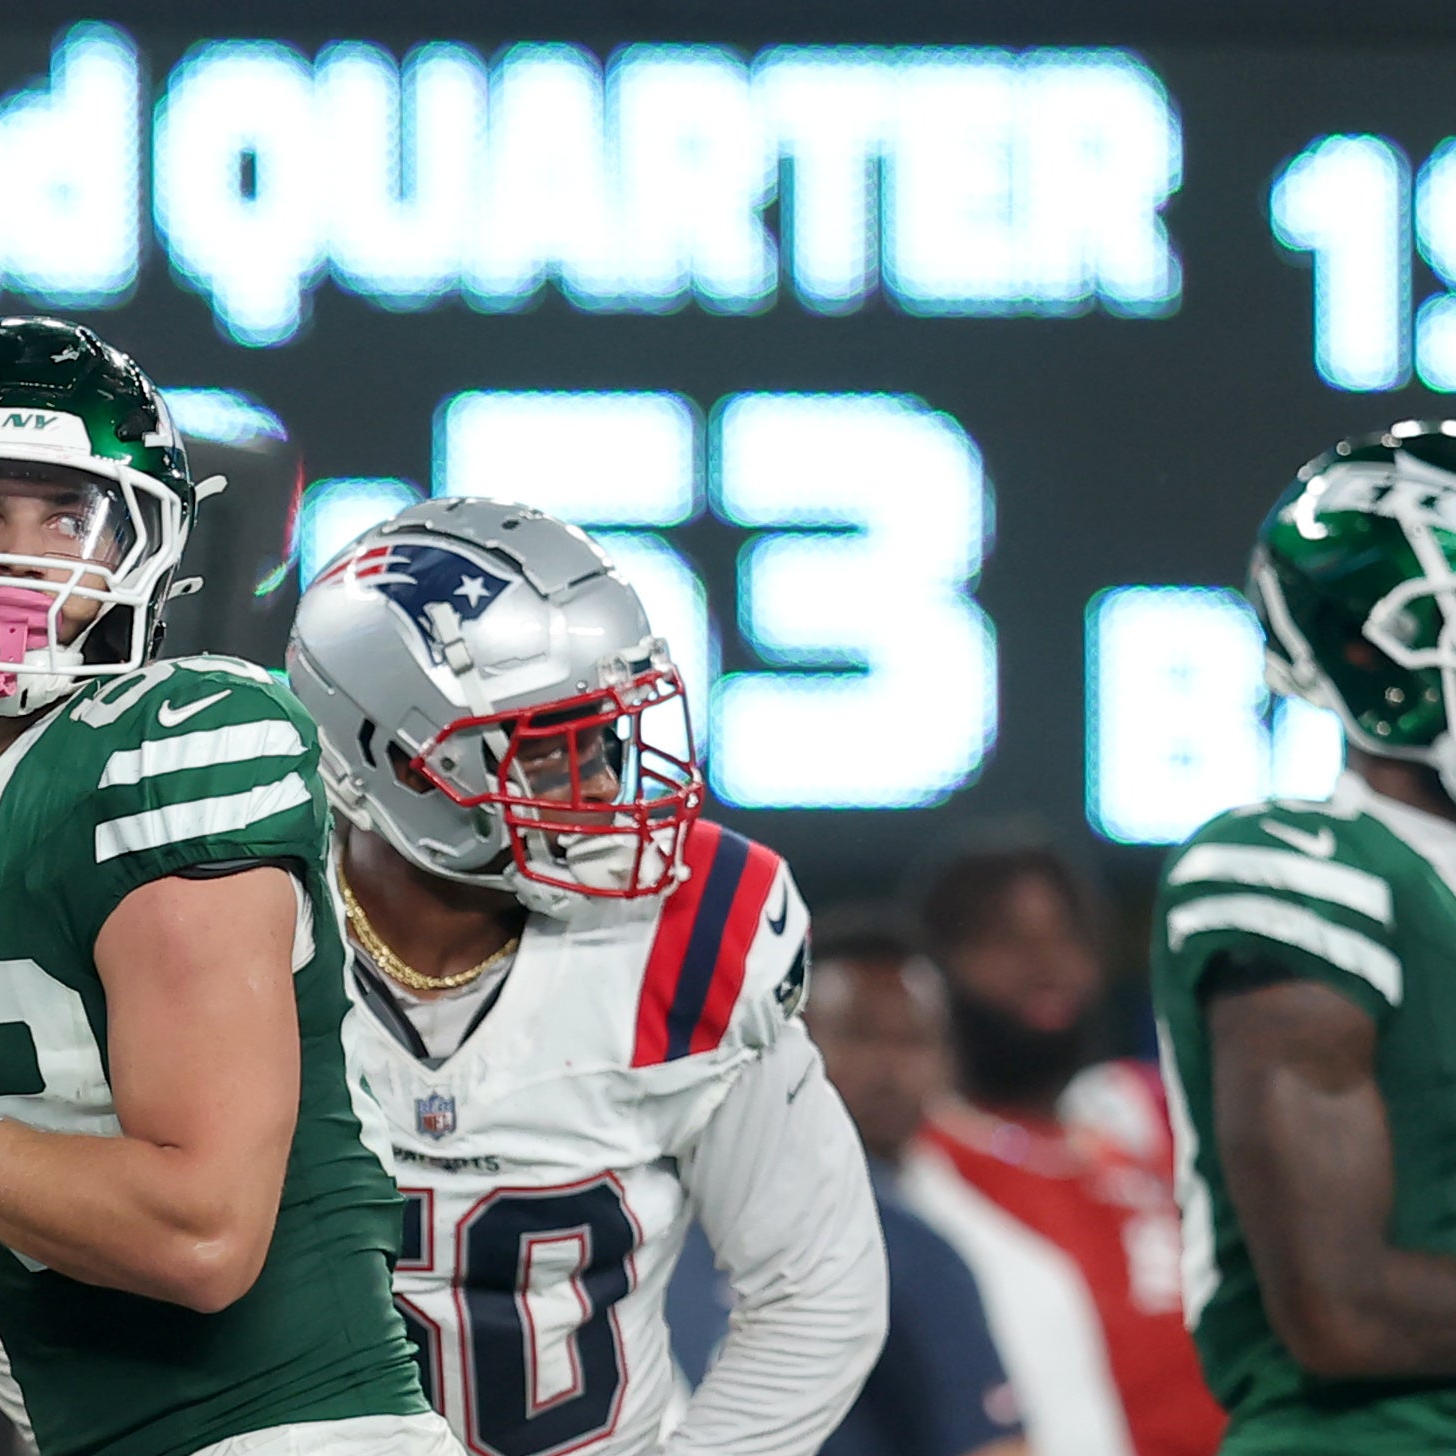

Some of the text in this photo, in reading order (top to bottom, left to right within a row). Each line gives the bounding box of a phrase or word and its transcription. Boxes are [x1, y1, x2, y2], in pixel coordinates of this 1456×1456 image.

[155, 42, 1183, 345] QUARTER
[1271, 136, 1456, 392] 1
[1, 413, 58, 429] NY
